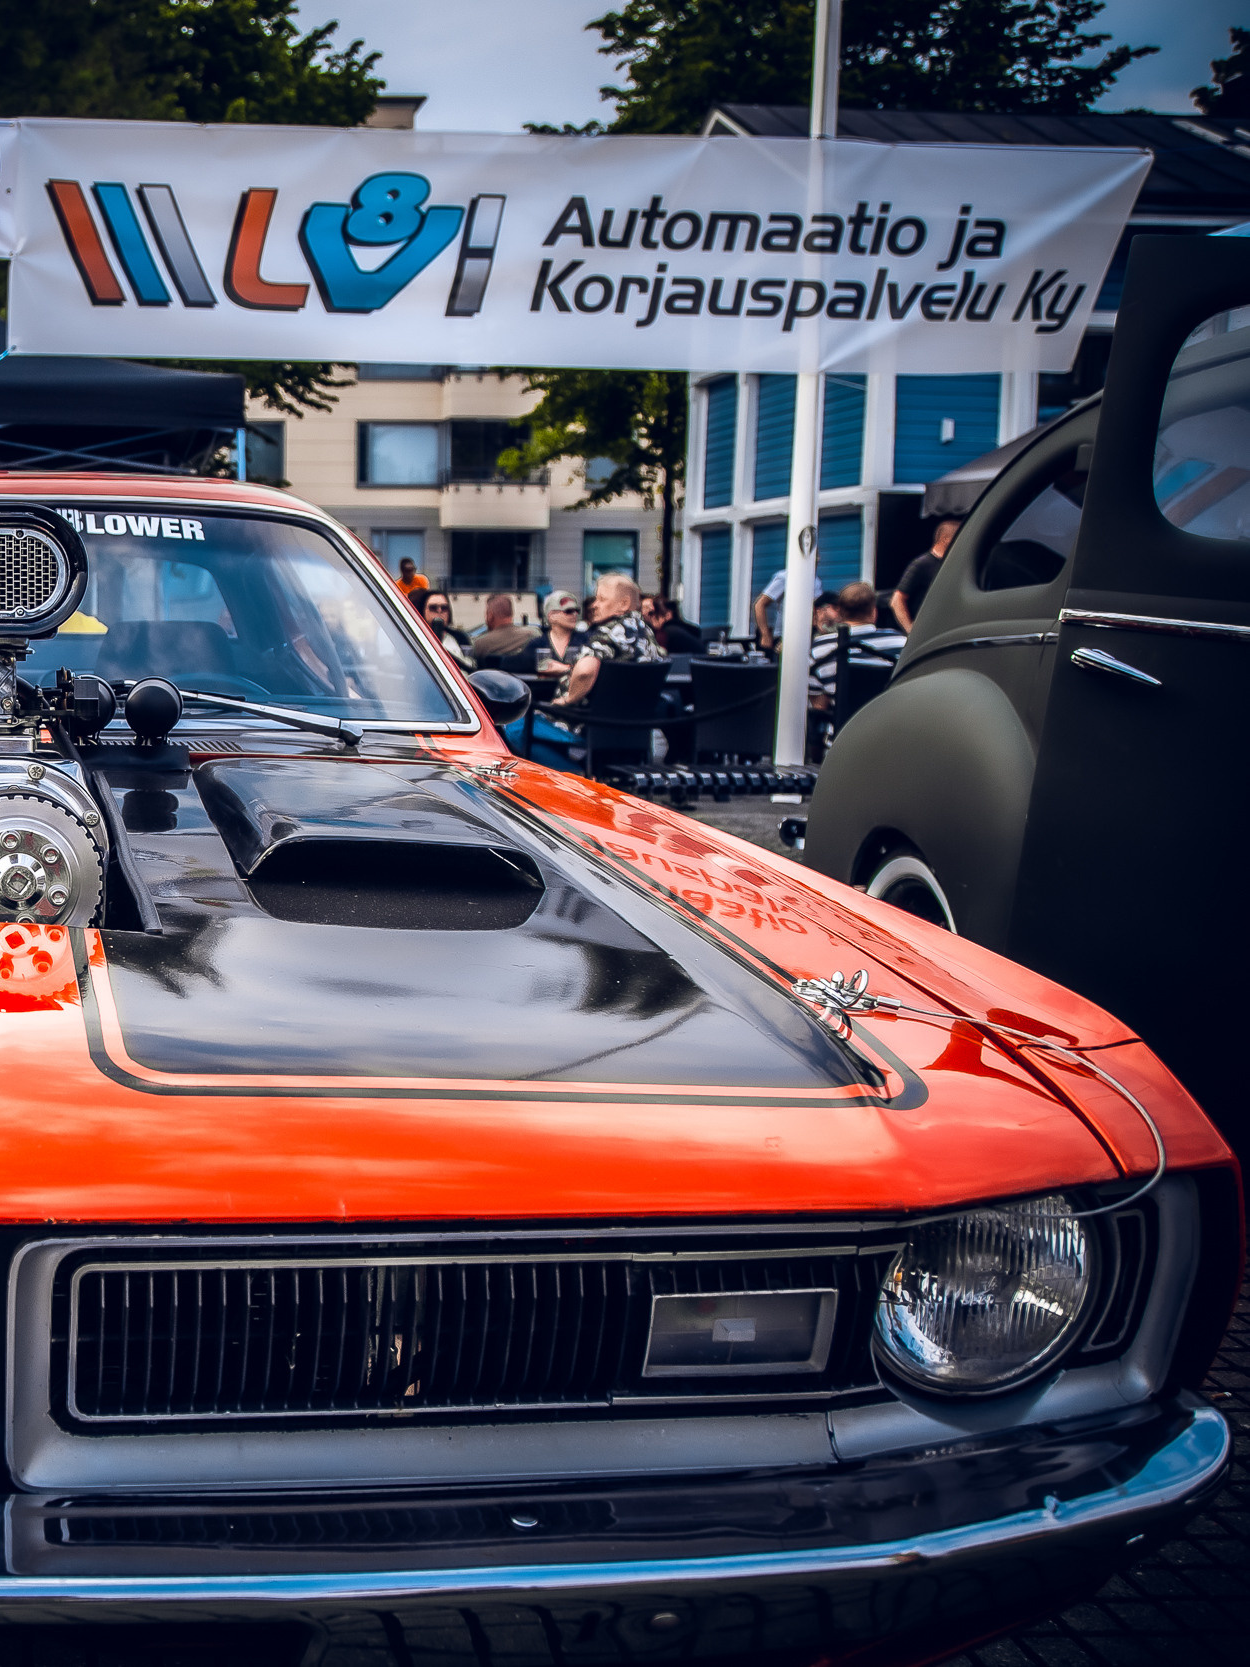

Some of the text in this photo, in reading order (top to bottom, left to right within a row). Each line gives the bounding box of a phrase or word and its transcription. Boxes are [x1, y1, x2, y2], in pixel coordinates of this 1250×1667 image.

[542, 195, 1007, 271] Automaatio ja
[530, 258, 1087, 334] Korjauspalvelu Ky
